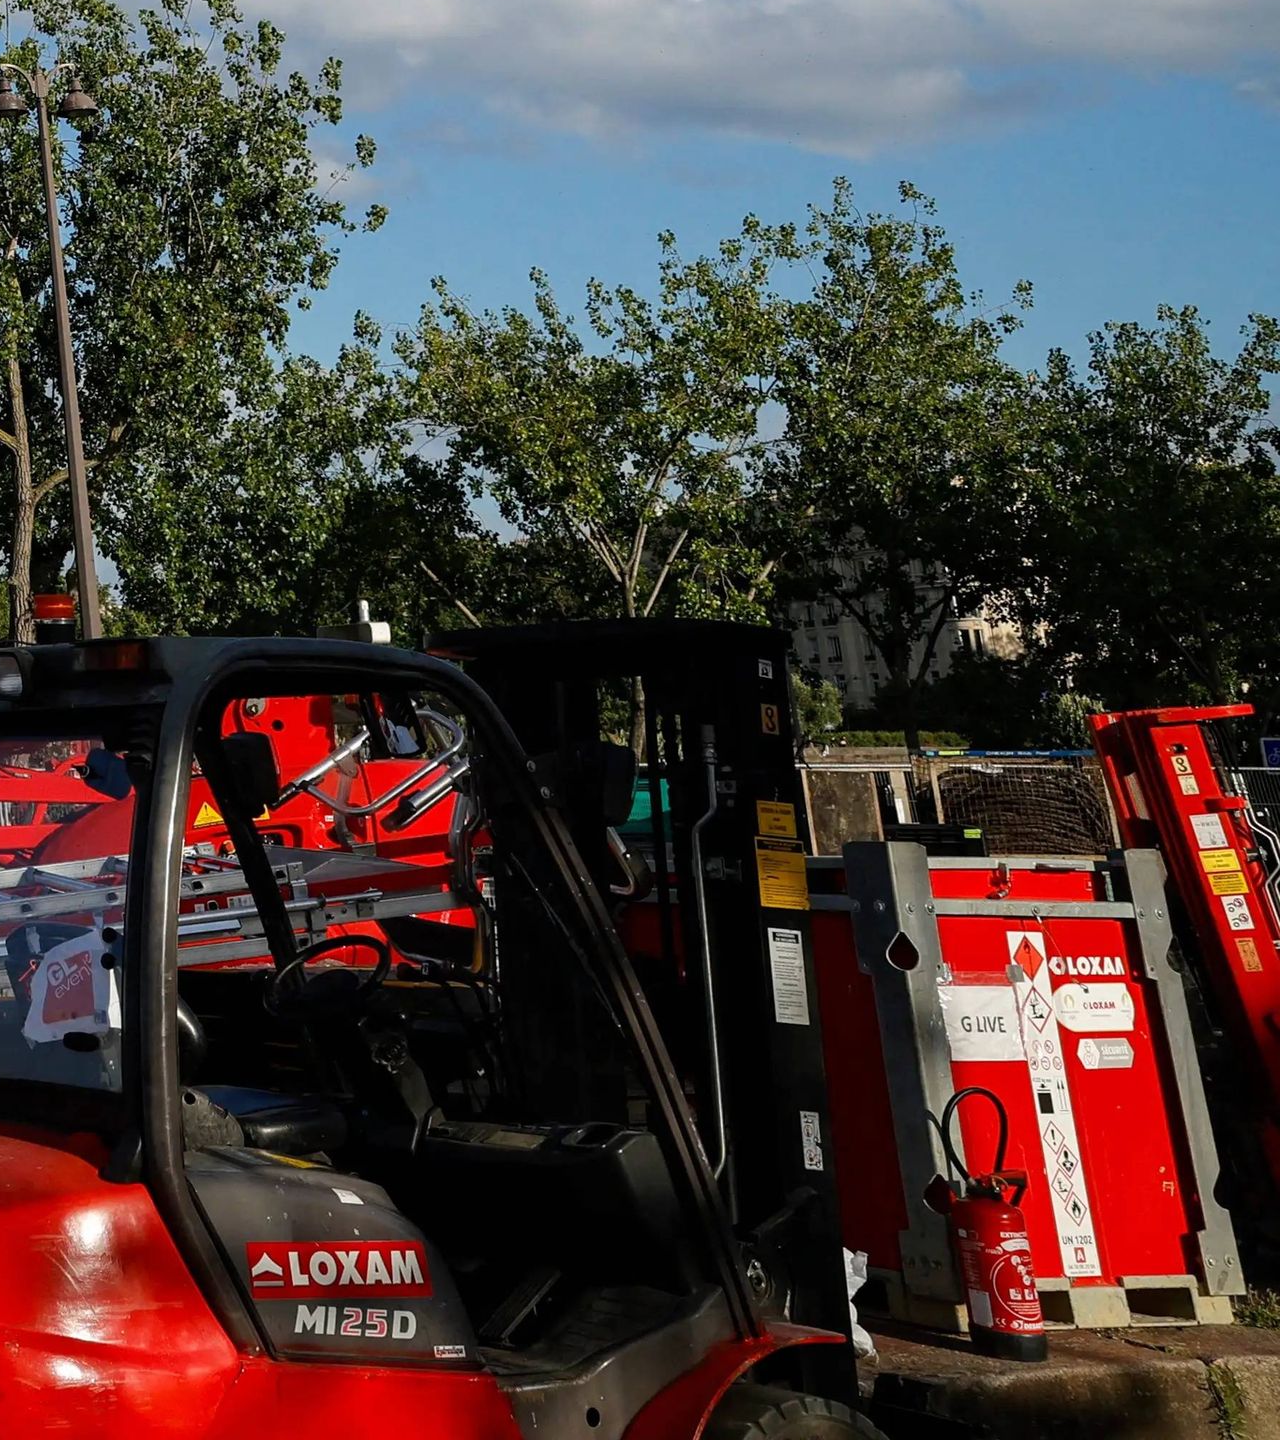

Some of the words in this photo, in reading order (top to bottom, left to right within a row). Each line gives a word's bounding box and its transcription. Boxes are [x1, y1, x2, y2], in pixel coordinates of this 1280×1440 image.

[1089, 1001, 1117, 1009] LOXAM
[961, 1015, 972, 1033] G
[976, 1015, 1007, 1033] LIVE
[1061, 1235, 1073, 1245] UN
[1075, 1235, 1092, 1245] 1202
[287, 1248, 424, 1287] LOXAM
